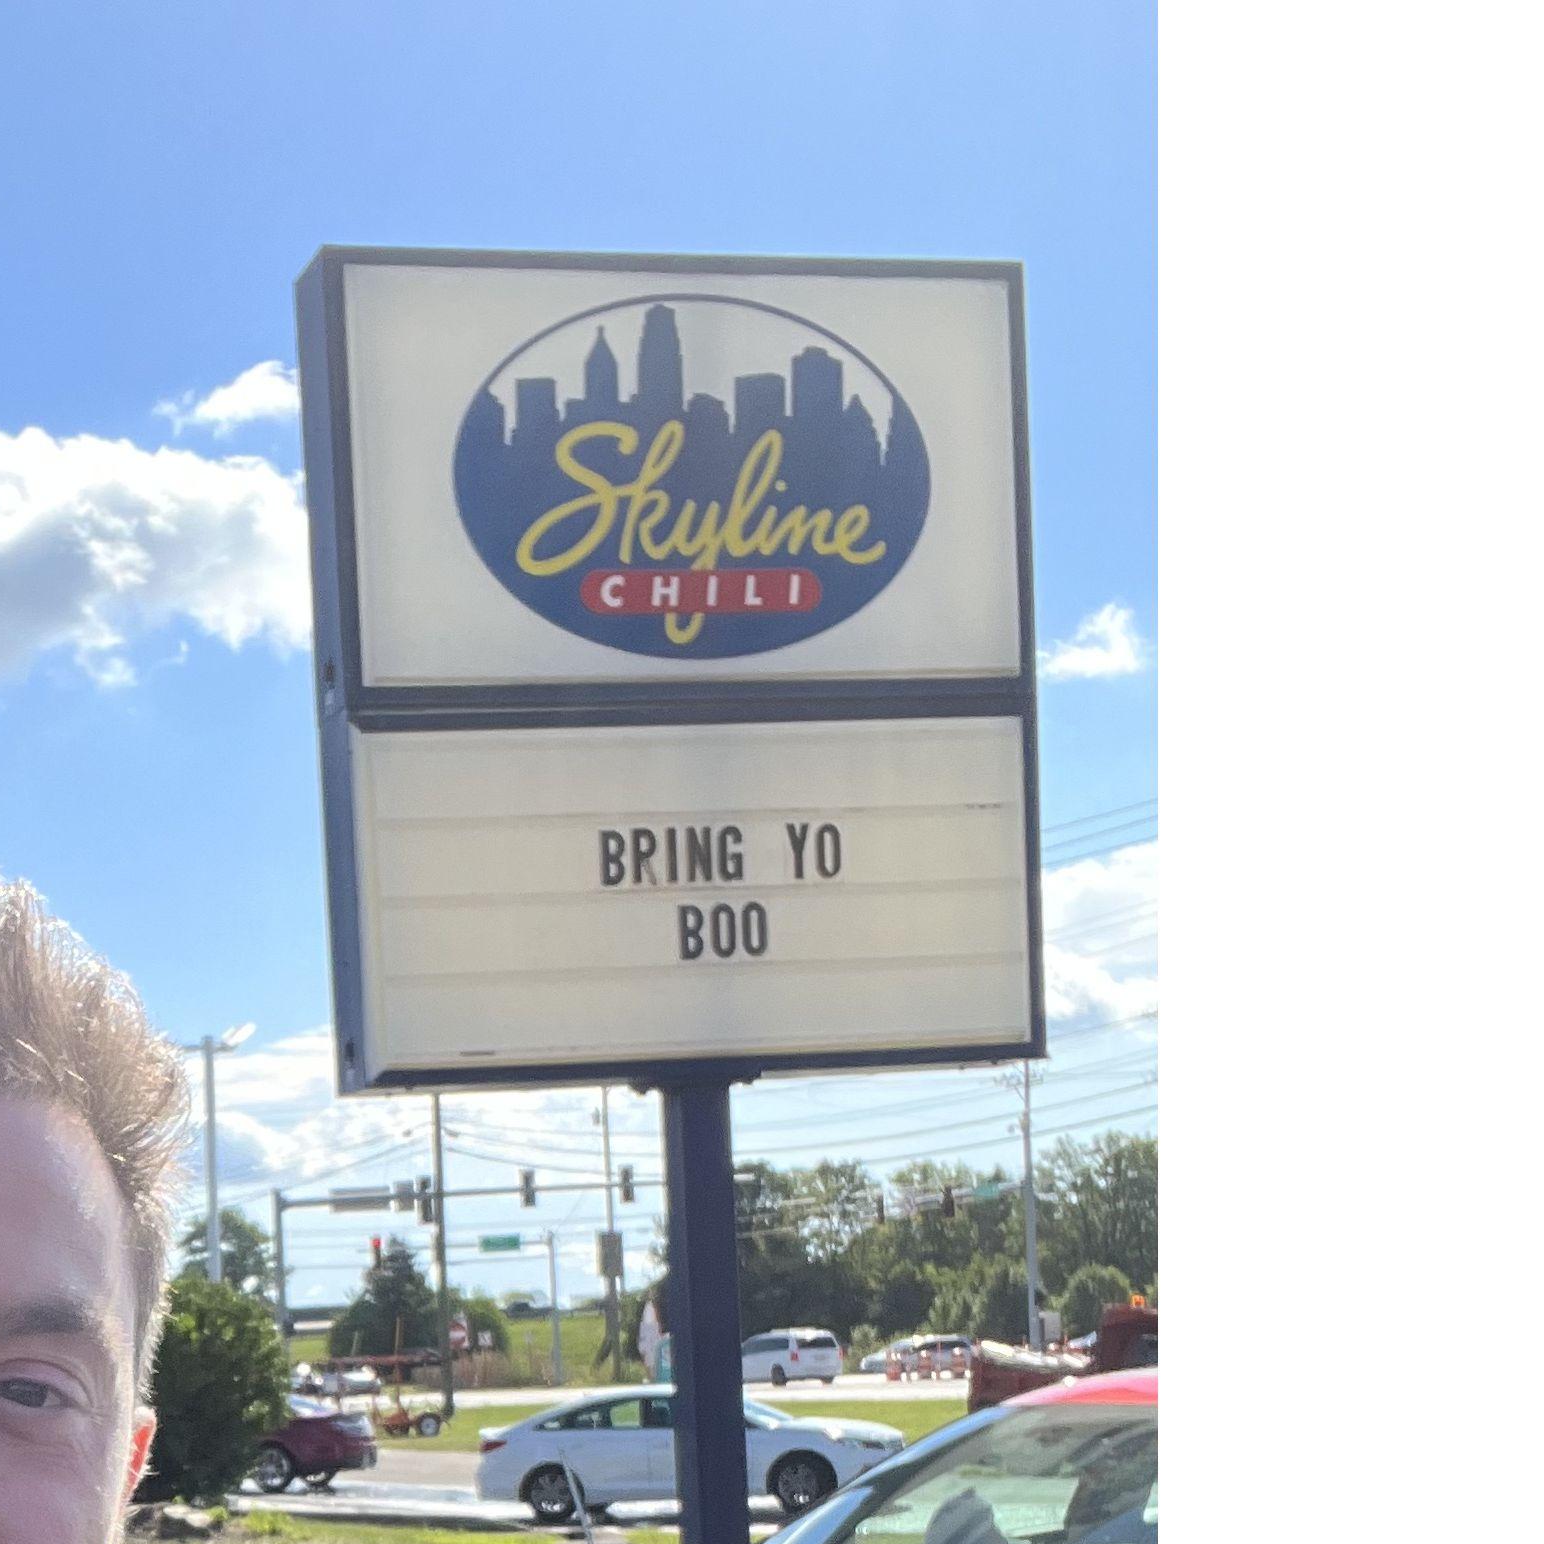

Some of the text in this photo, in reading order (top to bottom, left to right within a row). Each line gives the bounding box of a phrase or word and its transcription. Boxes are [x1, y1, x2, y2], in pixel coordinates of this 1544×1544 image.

[516, 420, 886, 645] Skyline
[600, 574, 801, 607] CHILI
[599, 823, 842, 886] BRING YO
[678, 901, 768, 960] BOO
